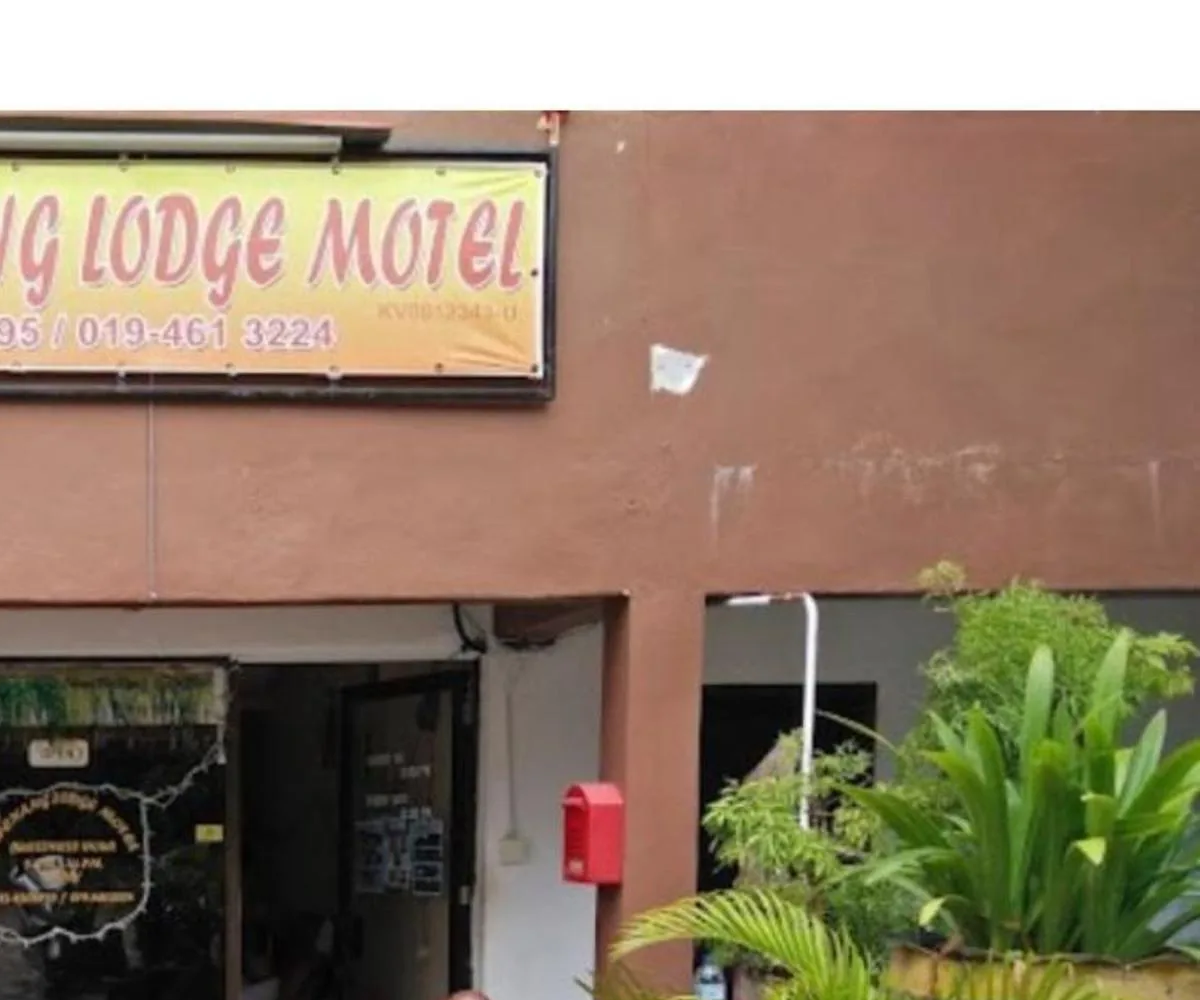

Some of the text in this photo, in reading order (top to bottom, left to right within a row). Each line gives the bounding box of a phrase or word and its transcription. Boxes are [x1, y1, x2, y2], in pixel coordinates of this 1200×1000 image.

[79, 192, 288, 310] LODGE
[305, 195, 527, 292] MOTEL
[52, 316, 68, 347] /
[76, 316, 228, 349] 019-461
[244, 317, 336, 349] 3224
